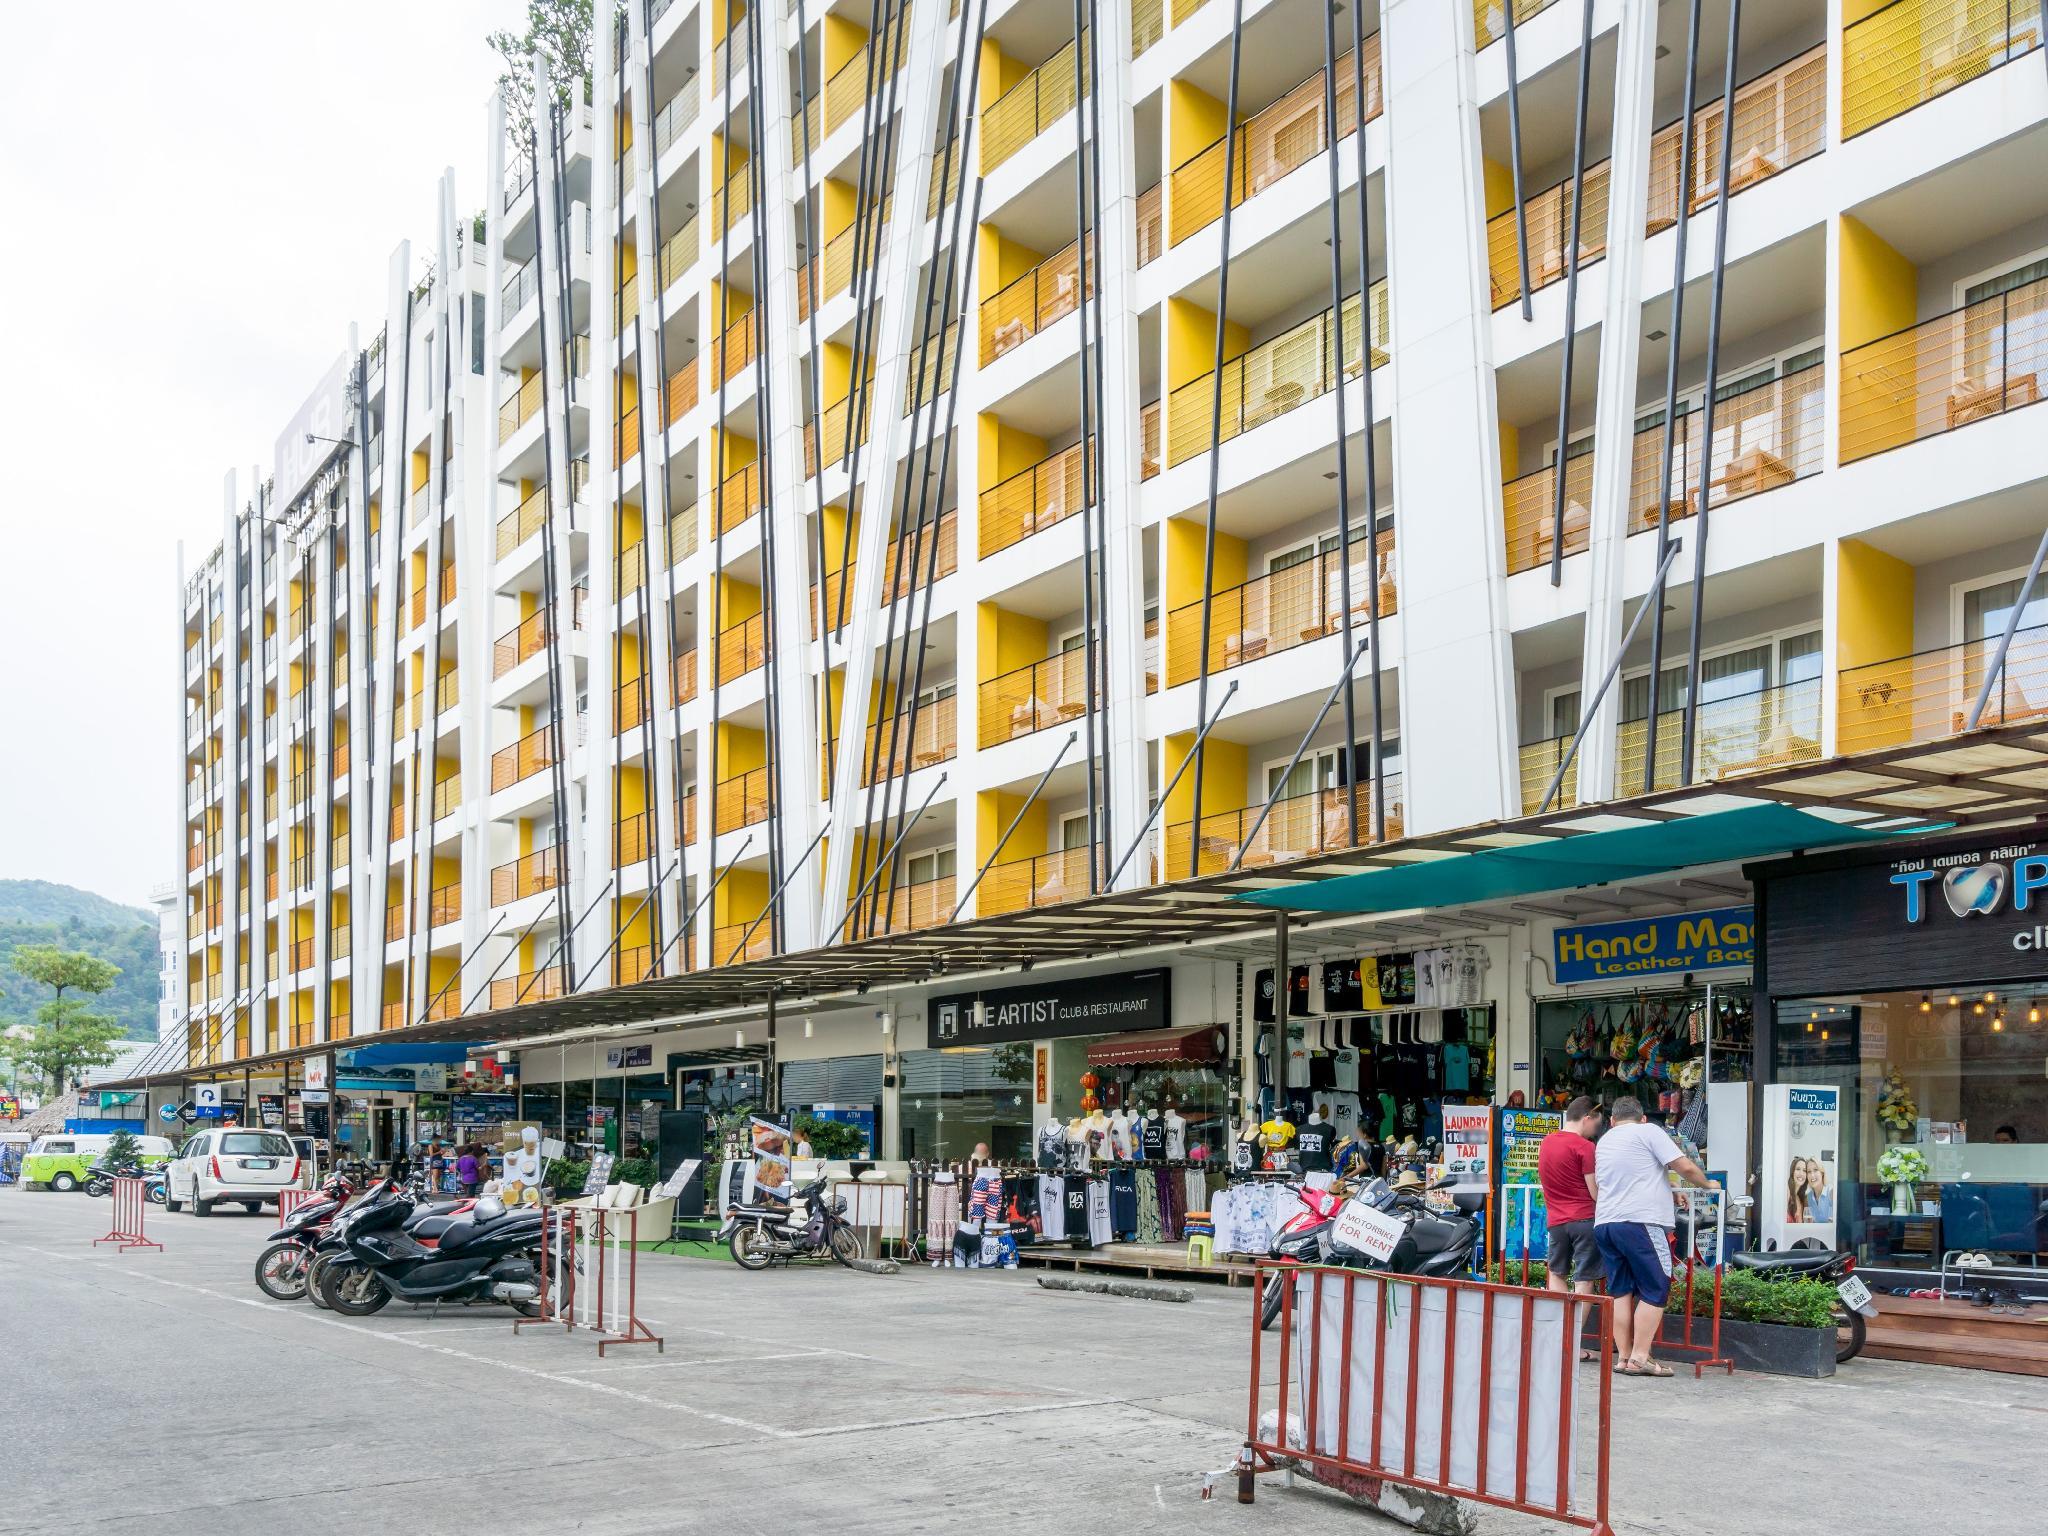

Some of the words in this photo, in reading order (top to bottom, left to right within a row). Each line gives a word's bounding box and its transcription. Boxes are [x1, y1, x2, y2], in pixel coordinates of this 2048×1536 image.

[1559, 925, 1658, 963] Hand
[1676, 918, 1755, 951] Ma
[1595, 956, 1695, 975] Leather
[997, 999, 1059, 1026] ARTIST
[1059, 1007, 1082, 1019] CLUB
[1083, 1007, 1089, 1017] &
[1090, 999, 1149, 1016] RESTAURANT
[846, 1111, 861, 1119] ATM
[1445, 1116, 1488, 1130] LAUNDRY
[1457, 1145, 1478, 1157] TAXI
[1339, 1223, 1360, 1239] FOR
[1365, 1235, 1394, 1254] RENT
[1346, 1213, 1395, 1241] MOTORBIKE
